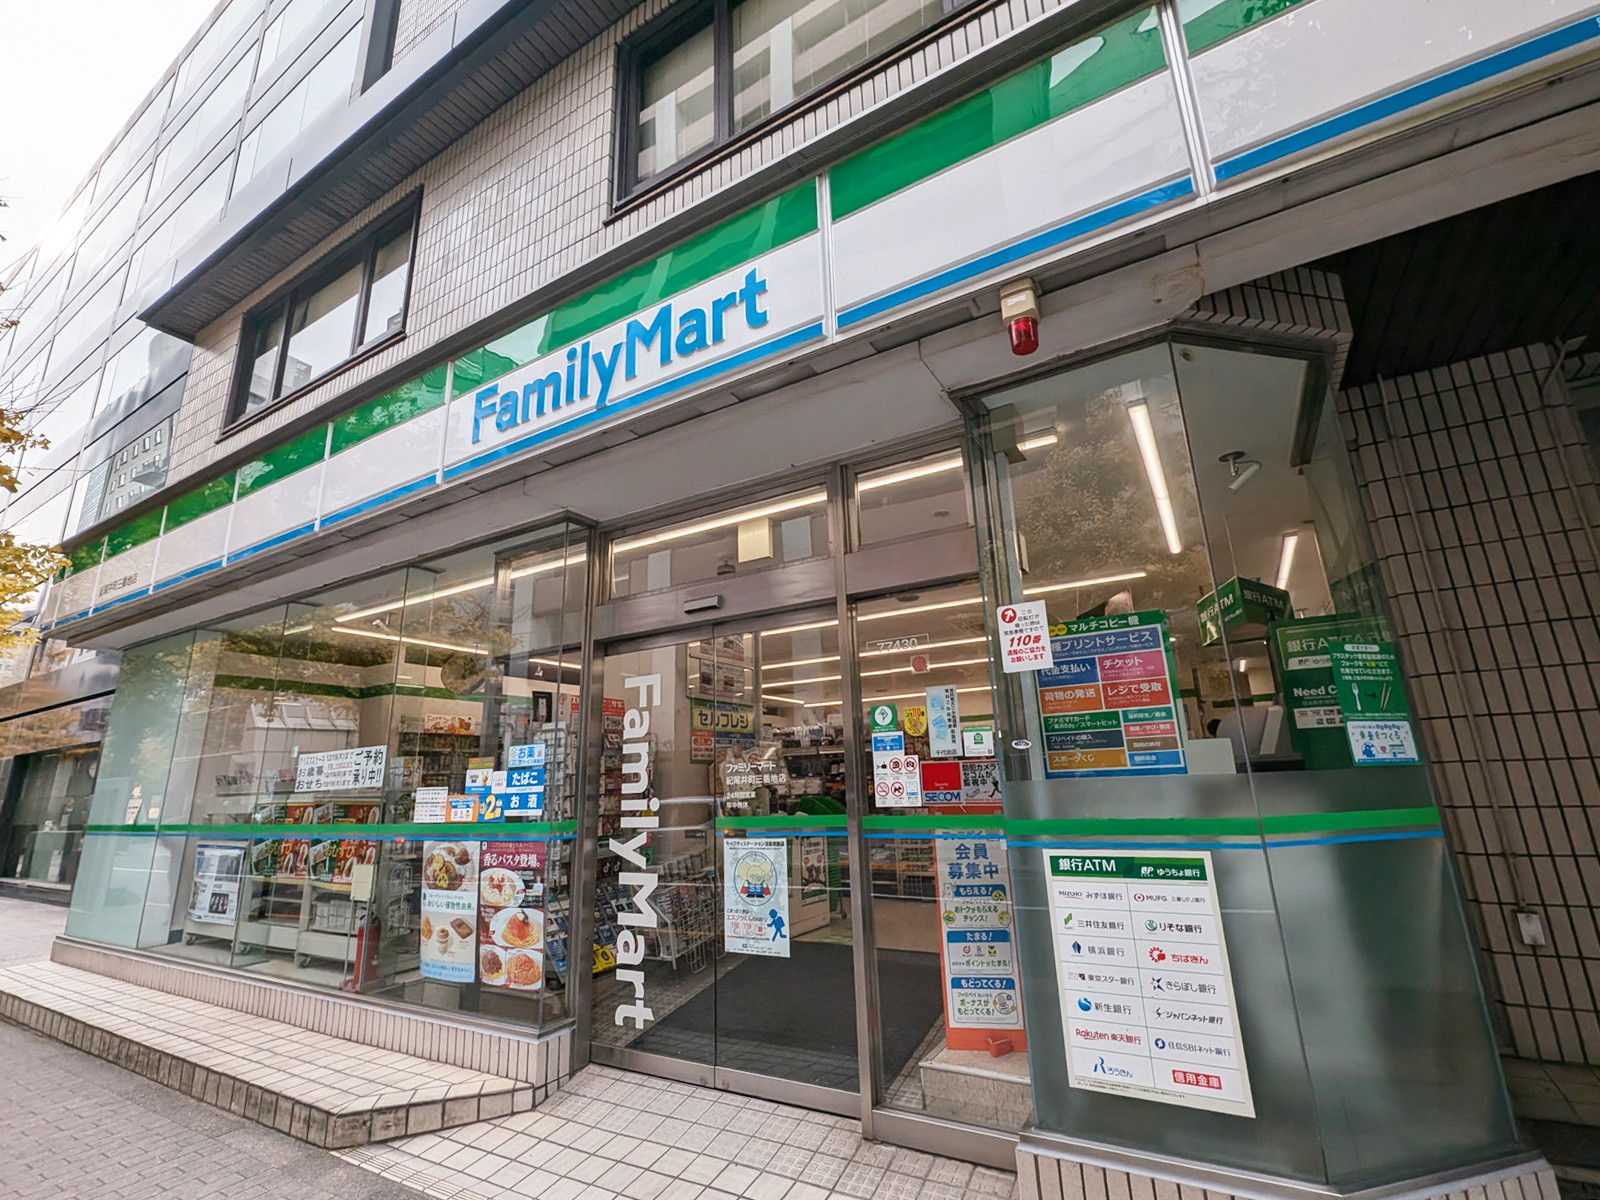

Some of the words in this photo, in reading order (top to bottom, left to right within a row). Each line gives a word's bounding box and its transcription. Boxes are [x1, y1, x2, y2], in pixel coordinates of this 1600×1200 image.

[471, 267, 769, 445] FamilyMart
[1068, 615, 1140, 633] マルチコピー機
[877, 638, 918, 653] 77430
[1009, 634, 1042, 648] 110番
[1103, 656, 1144, 669] チケット
[1292, 687, 1327, 697] Need
[726, 760, 777, 773] ファミリーマート
[511, 771, 538, 786] たばこ
[509, 793, 538, 809] お酒
[924, 791, 962, 802] SECOM
[608, 673, 662, 1030] FamilyMart
[955, 843, 988, 860] 会員
[483, 853, 541, 868] 香るパスタ登場。
[1058, 857, 1117, 873] 銀行ATM
[947, 862, 999, 880] 募集中
[1156, 868, 1201, 878] ゆうちょ銀行
[959, 886, 992, 896] もらえる！
[1058, 890, 1083, 898] MIZUHO
[1085, 892, 1123, 901] みずほ銀行
[1077, 920, 1125, 931] 三井住友銀行
[1159, 923, 1203, 934] りそな銀行
[966, 932, 993, 941] たまる！
[1087, 945, 1125, 957] 横浜銀行
[960, 979, 1007, 989] もどってくる！
[1087, 974, 1135, 986] 東京スター銀行
[1165, 981, 1216, 995] きらぼし銀行
[957, 1008, 995, 1016] もどってくる！
[1094, 1002, 1132, 1015] 新生銀行
[1165, 1011, 1224, 1025] ジャパンネット銀行
[1075, 1028, 1110, 1041] Rakuten
[1110, 1033, 1142, 1045] 楽天銀行
[1168, 1041, 1231, 1057] 住信SBIネット銀行
[1174, 1072, 1222, 1089] 信用金庫
